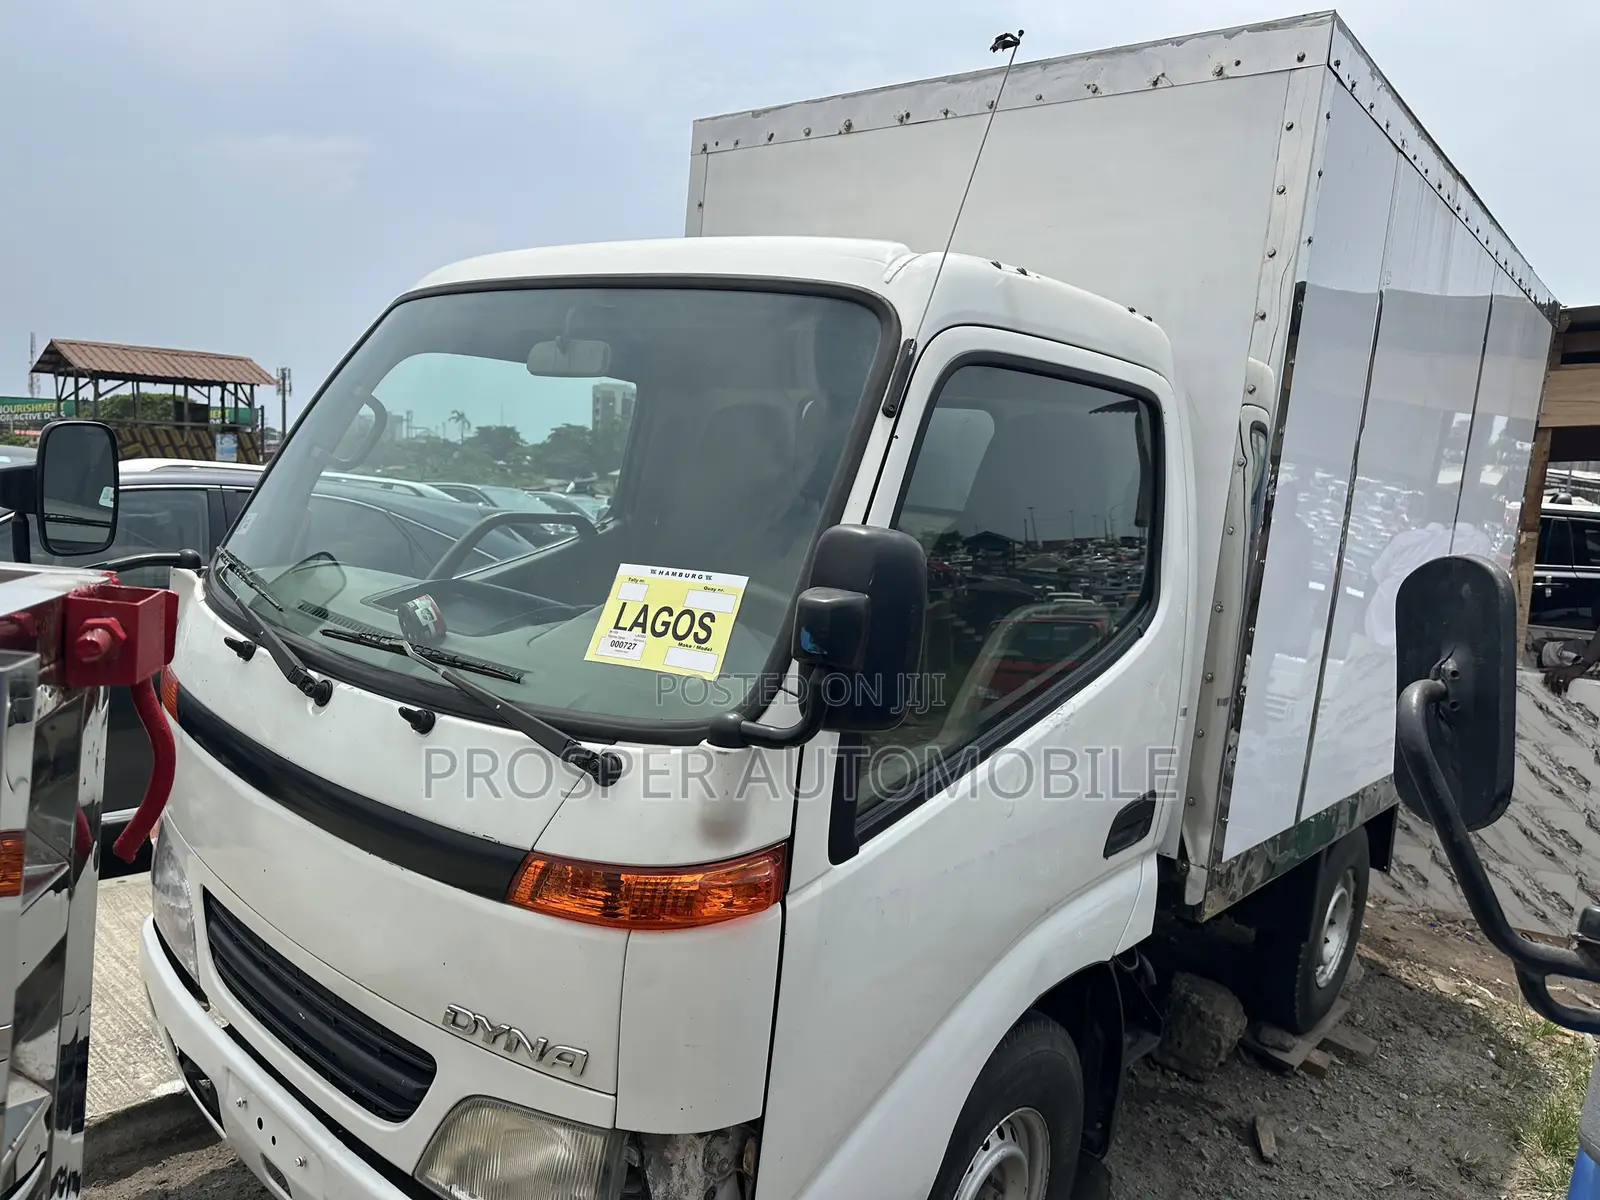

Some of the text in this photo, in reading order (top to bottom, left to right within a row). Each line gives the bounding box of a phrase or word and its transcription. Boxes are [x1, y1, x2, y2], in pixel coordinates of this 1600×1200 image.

[658, 570, 703, 580] HAMBURG
[613, 602, 716, 645] LAGOS
[610, 640, 637, 651] 000727
[441, 1002, 589, 1076] DYNA
